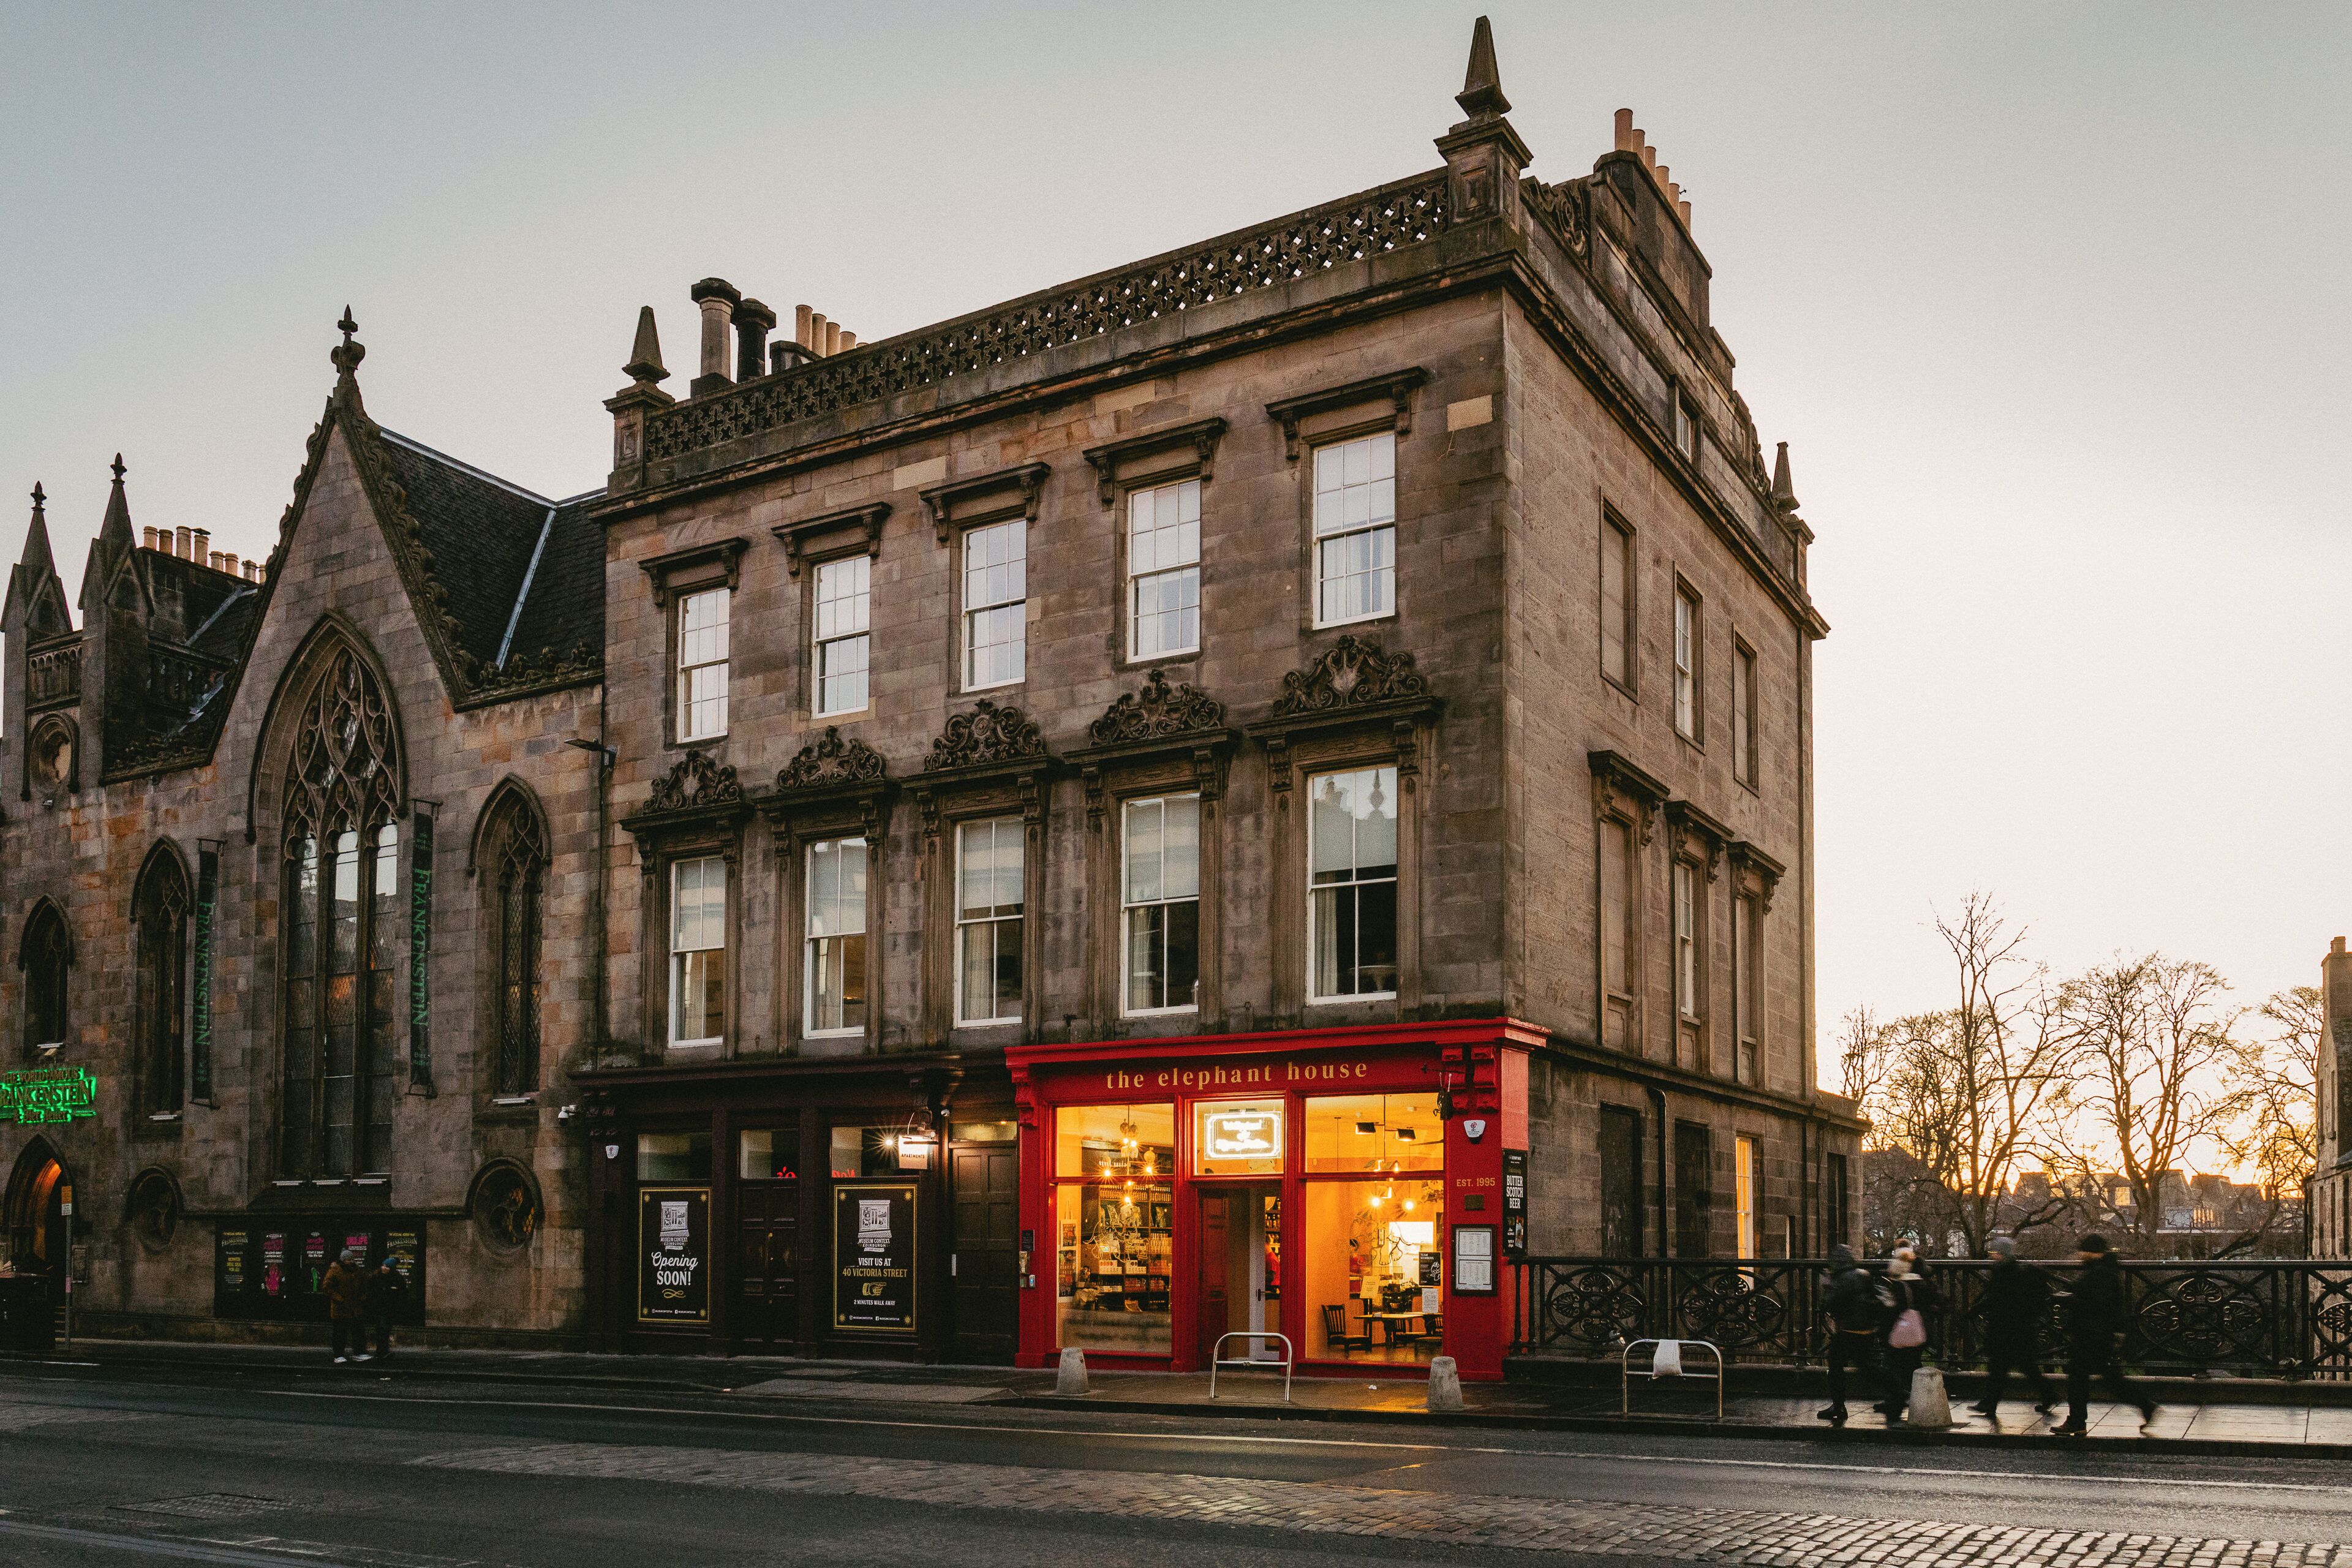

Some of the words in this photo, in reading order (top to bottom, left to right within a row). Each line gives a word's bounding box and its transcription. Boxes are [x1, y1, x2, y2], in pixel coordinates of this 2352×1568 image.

[411, 867, 431, 1025] FRANKENSTEIN
[1106, 1070, 1144, 1089] the
[1158, 1064, 1273, 1090] elephant
[1287, 1061, 1367, 1080] house
[0, 1078, 92, 1106] RANKENSTEIN
[1476, 1177, 1496, 1186] 1995
[1506, 1175, 1523, 1187] BUTTER
[1506, 1186, 1524, 1198] SCOTCH
[1509, 1198, 1521, 1209] BEER
[651, 1251, 698, 1270] Opening
[858, 1257, 874, 1266] VISIT
[875, 1257, 883, 1267] US
[883, 1258, 892, 1267] AT
[657, 1270, 691, 1286] SOON!
[842, 1268, 851, 1276] 40
[852, 1268, 882, 1277] VICTORIA
[883, 1268, 908, 1278] STREET
